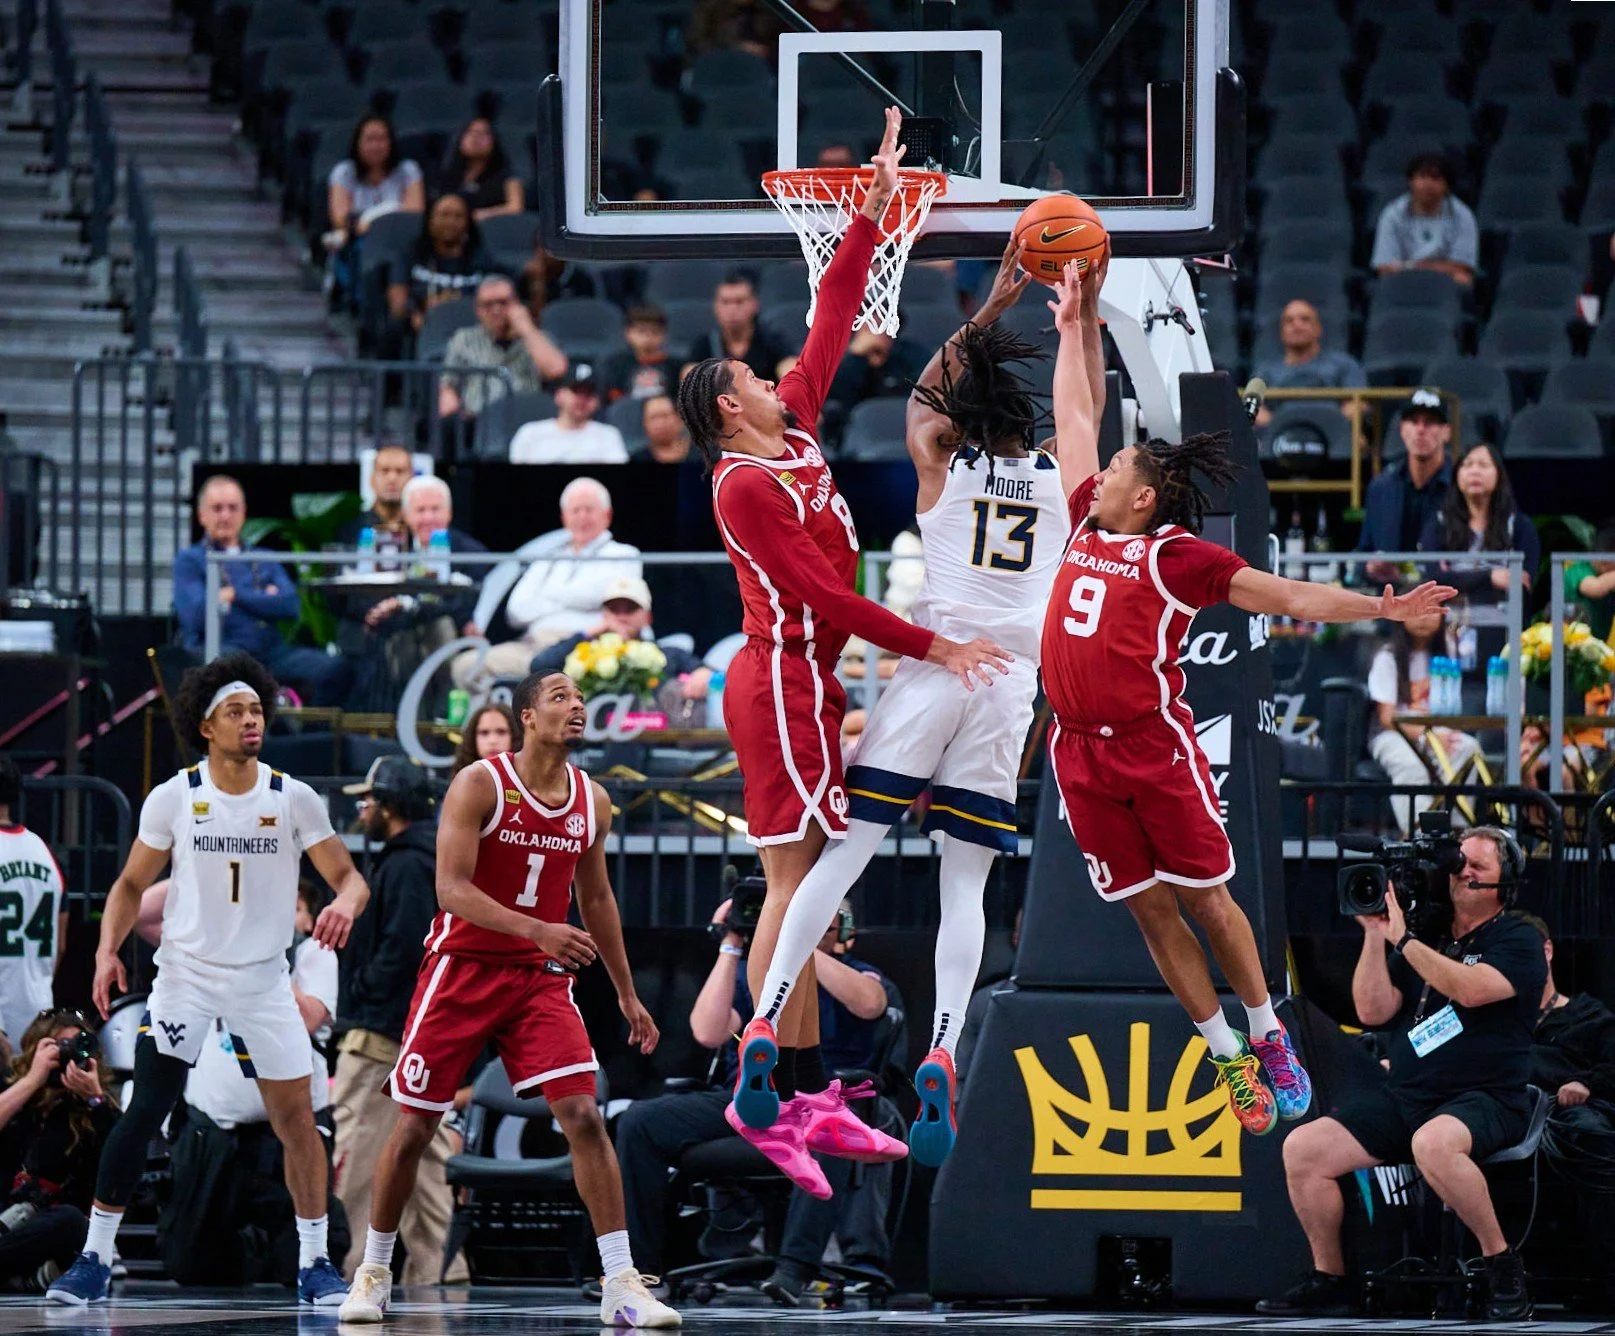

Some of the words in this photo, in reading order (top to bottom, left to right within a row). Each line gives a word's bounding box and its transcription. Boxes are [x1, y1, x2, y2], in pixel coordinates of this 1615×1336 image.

[1041, 256, 1088, 272] ELE
[984, 474, 1035, 500] MOORE
[830, 492, 860, 552] 8
[970, 498, 1039, 573] 13
[1066, 549, 1140, 580] OKLAHOMA
[1122, 539, 1146, 562] SEC
[1063, 574, 1107, 638] 9
[193, 835, 279, 854] MOUNTAINEERS
[498, 829, 582, 854] OKLAHOMA
[0, 860, 51, 883] BRYANT
[228, 861, 241, 904] 1
[515, 853, 546, 908] 1
[0, 890, 54, 957] 24
[402, 1052, 431, 1094] OU
